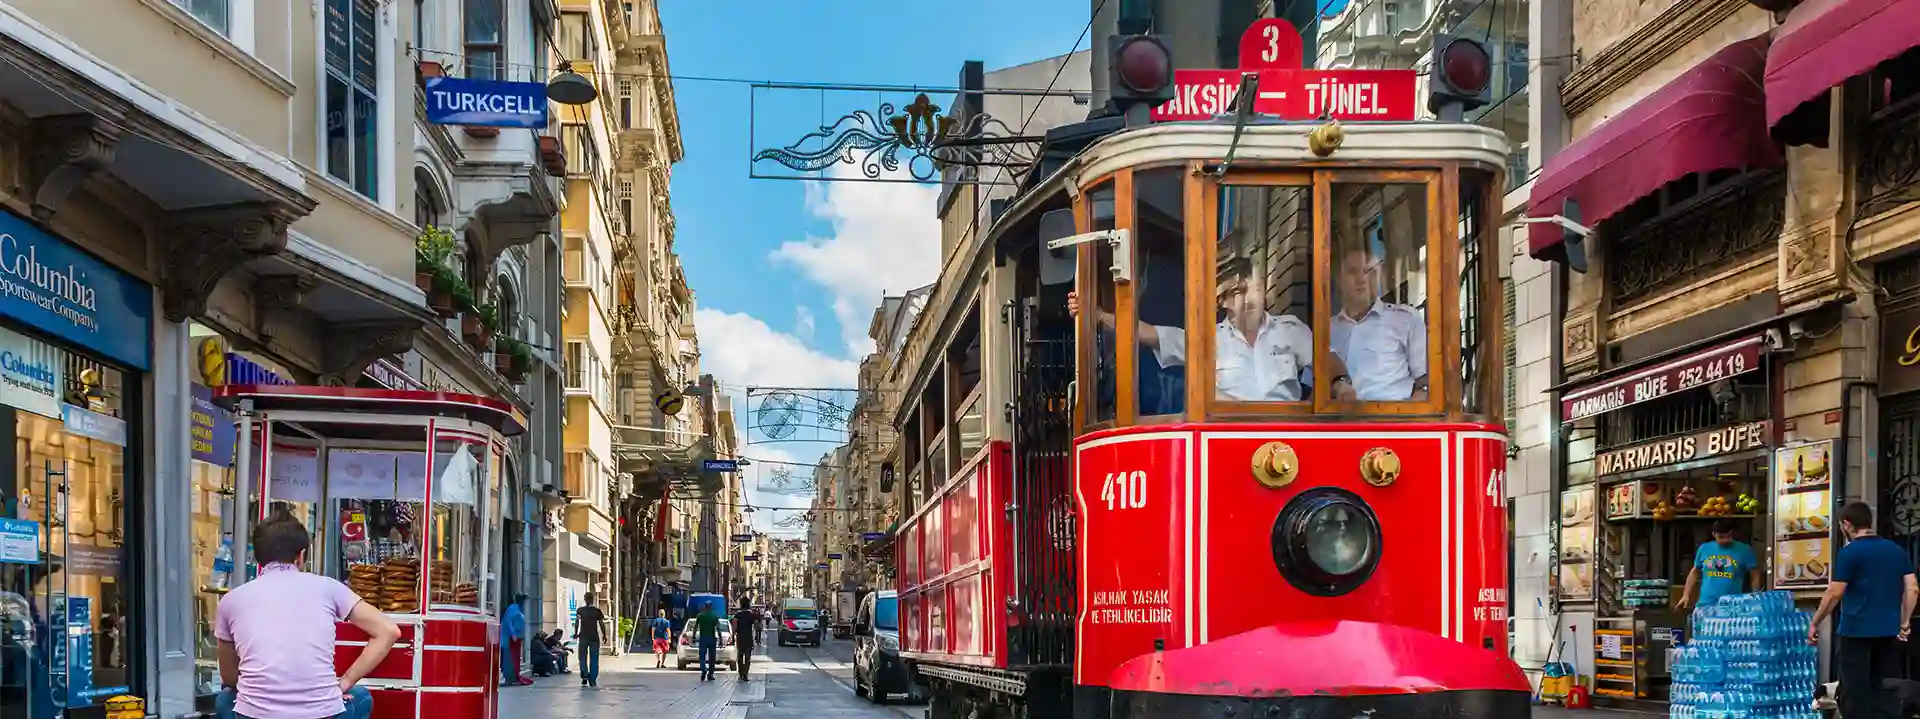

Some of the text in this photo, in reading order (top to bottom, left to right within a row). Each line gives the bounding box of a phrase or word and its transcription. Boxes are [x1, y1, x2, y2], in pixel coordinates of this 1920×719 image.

[1261, 25, 1280, 63] 3
[432, 90, 541, 114] TURKCELL
[1157, 78, 1241, 116] AKSİ
[1304, 77, 1388, 115] TÜNEL
[0, 233, 97, 312] Columbia
[1, 350, 55, 385] Columbia
[1635, 375, 1668, 402] BÜFE
[1678, 366, 1704, 389] 252
[1706, 360, 1724, 380] 44
[1726, 352, 1745, 374] 19
[1599, 423, 1763, 476] MARMARİS BÜFE
[1101, 470, 1147, 511] 410
[1486, 468, 1508, 508] 41
[1093, 589, 1169, 605] ASILHAK YASAK
[1473, 607, 1486, 621] VE
